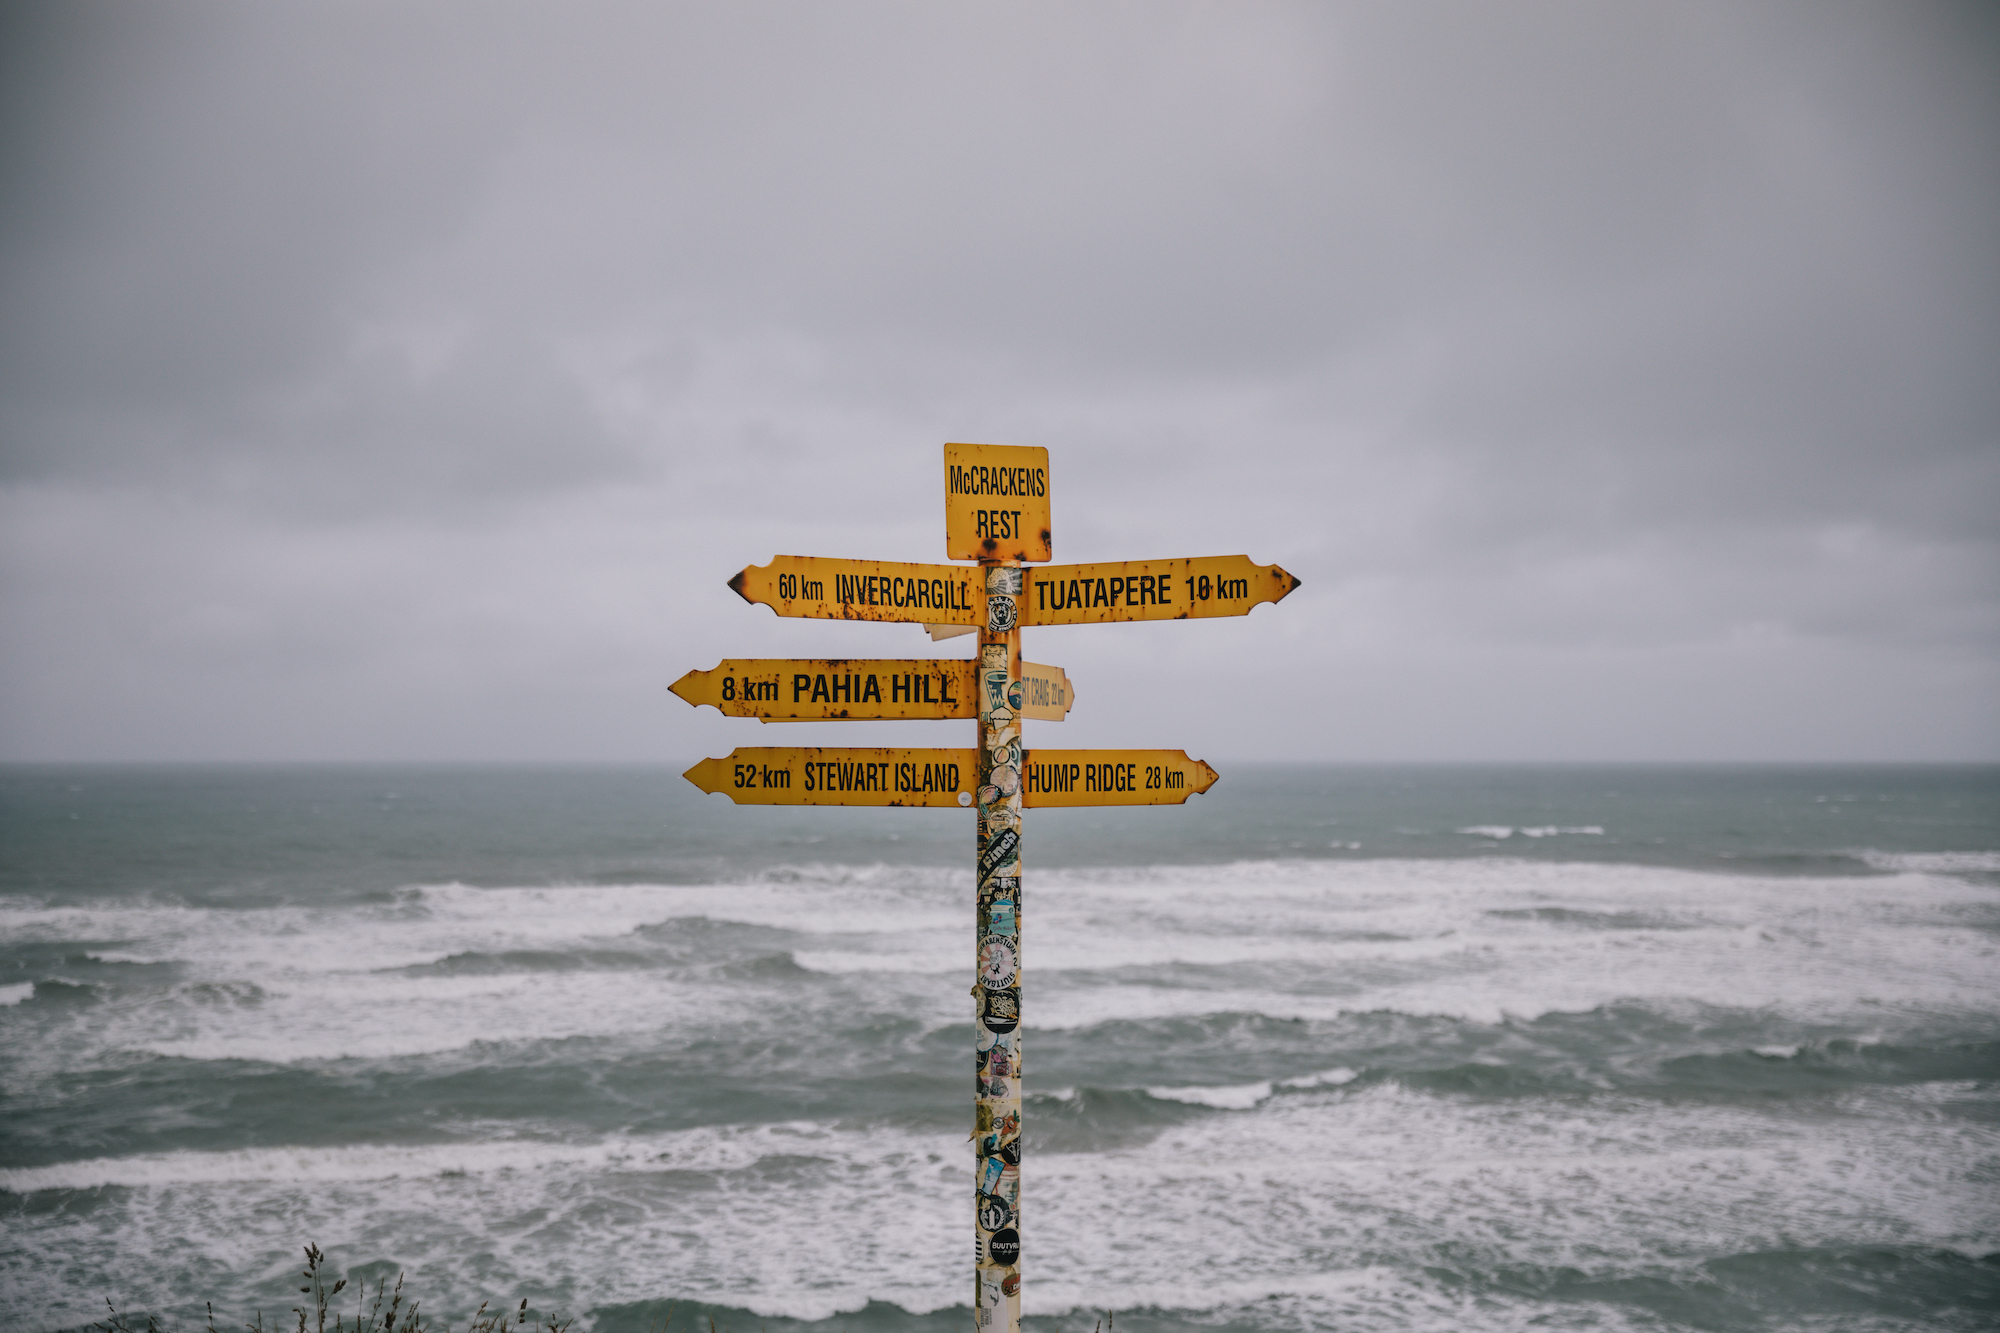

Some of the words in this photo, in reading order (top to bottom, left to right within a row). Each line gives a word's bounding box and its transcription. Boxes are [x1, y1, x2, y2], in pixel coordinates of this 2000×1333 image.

[950, 465, 1045, 498] McCRACKENS
[977, 509, 1021, 540] REST
[778, 573, 797, 600] 60
[801, 574, 824, 601] km
[835, 573, 971, 611] INVERCARGILL
[1035, 574, 1172, 611] TUATAPERE
[1185, 574, 1210, 601] 10
[1217, 573, 1249, 600] km
[721, 676, 736, 701] 8
[743, 676, 779, 701] km
[793, 674, 882, 703] PAHIA
[892, 674, 957, 704] HILL
[1022, 675, 1031, 706] RT
[1031, 676, 1050, 708] CRAIG
[1057, 682, 1065, 707] km
[733, 764, 757, 789] 52
[762, 764, 791, 789] km
[804, 762, 889, 792] STEWART
[895, 763, 960, 793] ISLAND
[1028, 763, 1080, 793] HUMP
[1085, 763, 1136, 792] RIDGE
[1145, 765, 1161, 789] 28
[1165, 765, 1184, 789] km
[983, 831, 1017, 869] Finch
[977, 935, 1016, 956] SCHWABENSTURM
[980, 971, 1015, 987] STUTTGART
